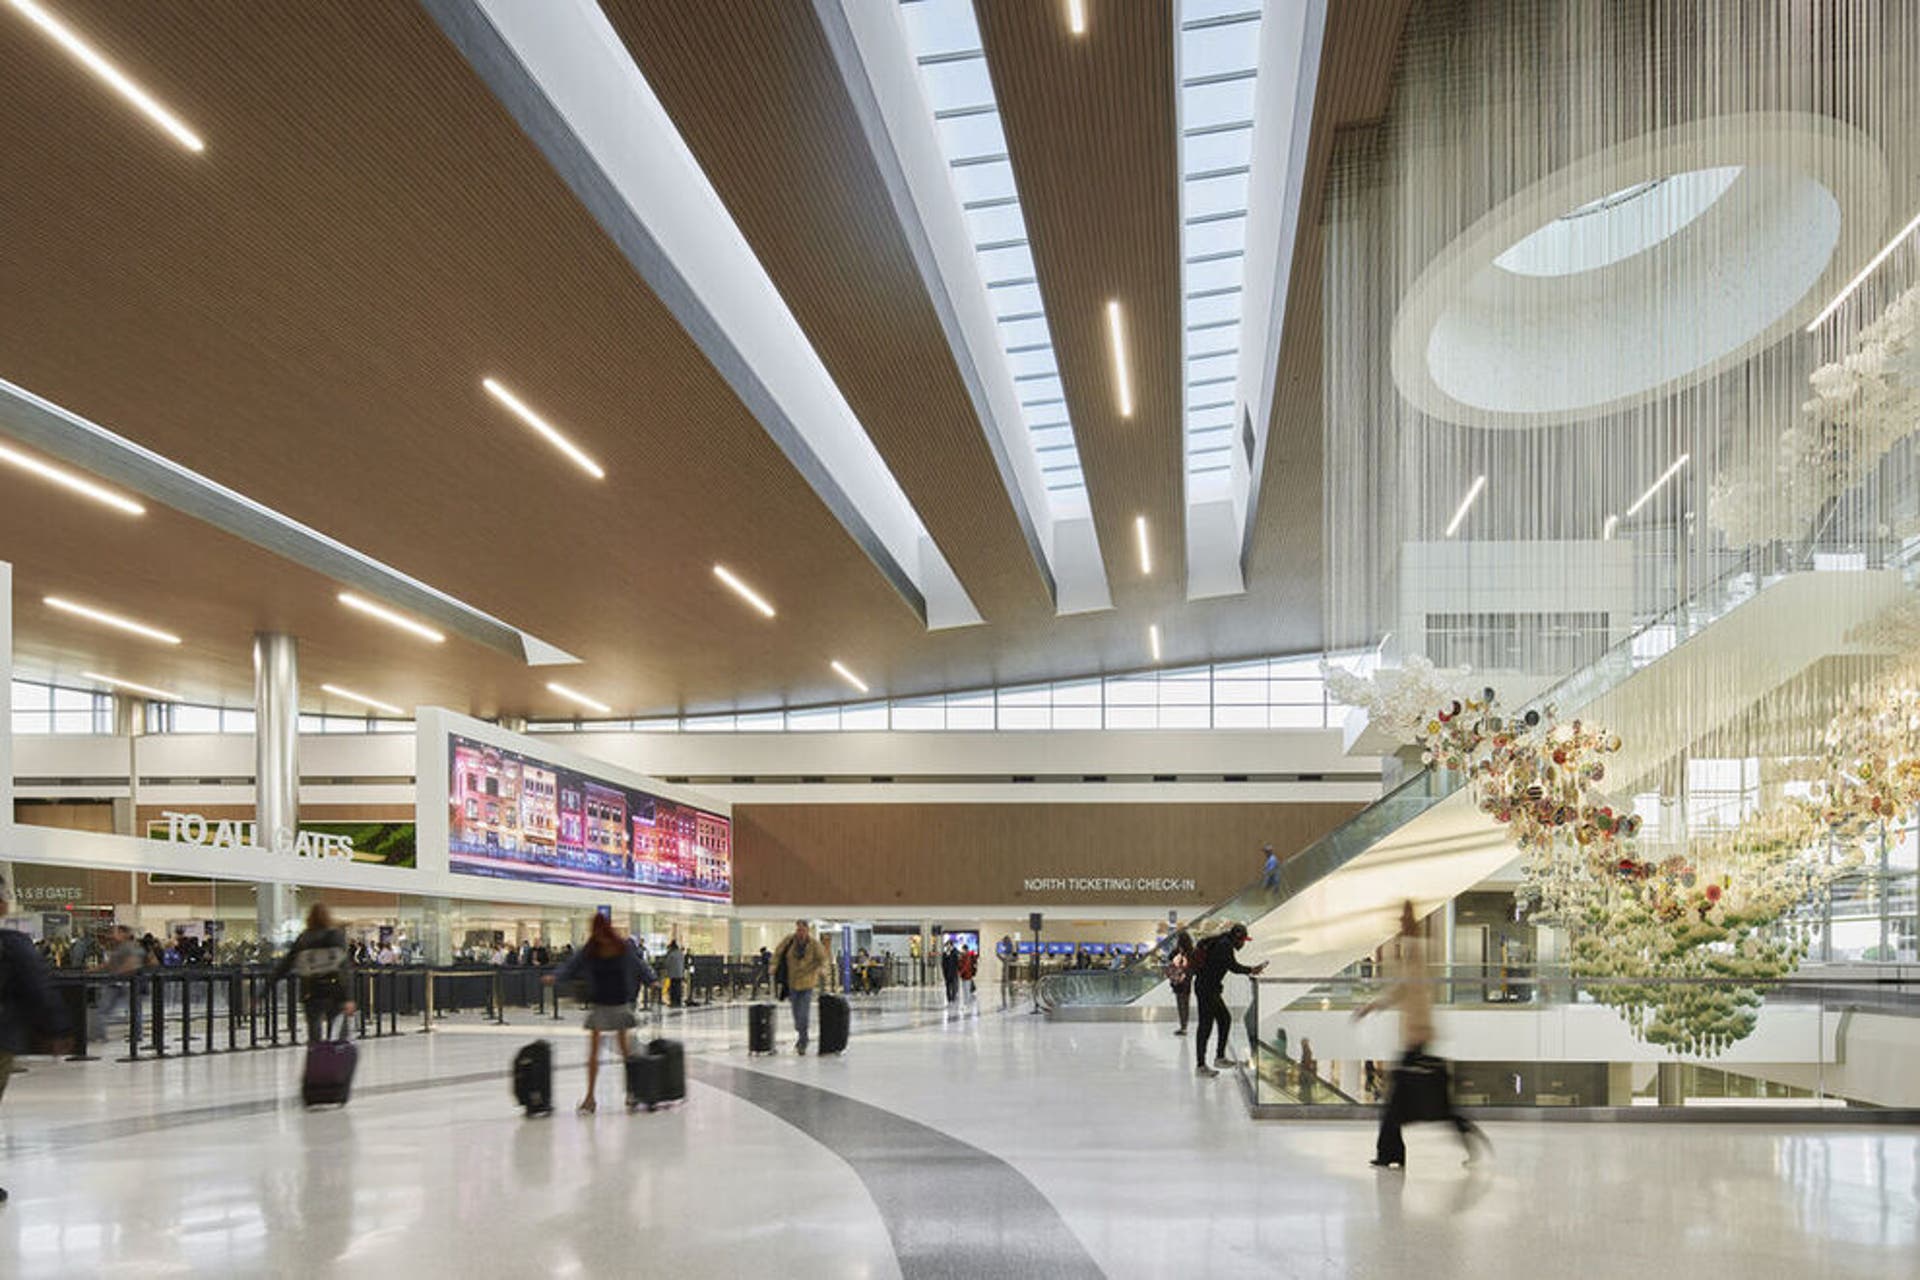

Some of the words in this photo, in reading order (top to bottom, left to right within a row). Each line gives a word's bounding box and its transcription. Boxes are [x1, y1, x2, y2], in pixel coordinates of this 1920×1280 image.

[162, 811, 207, 845] TO
[275, 826, 354, 861] GATES
[1024, 878, 1066, 891] NORTH
[46, 887, 82, 899] GATES
